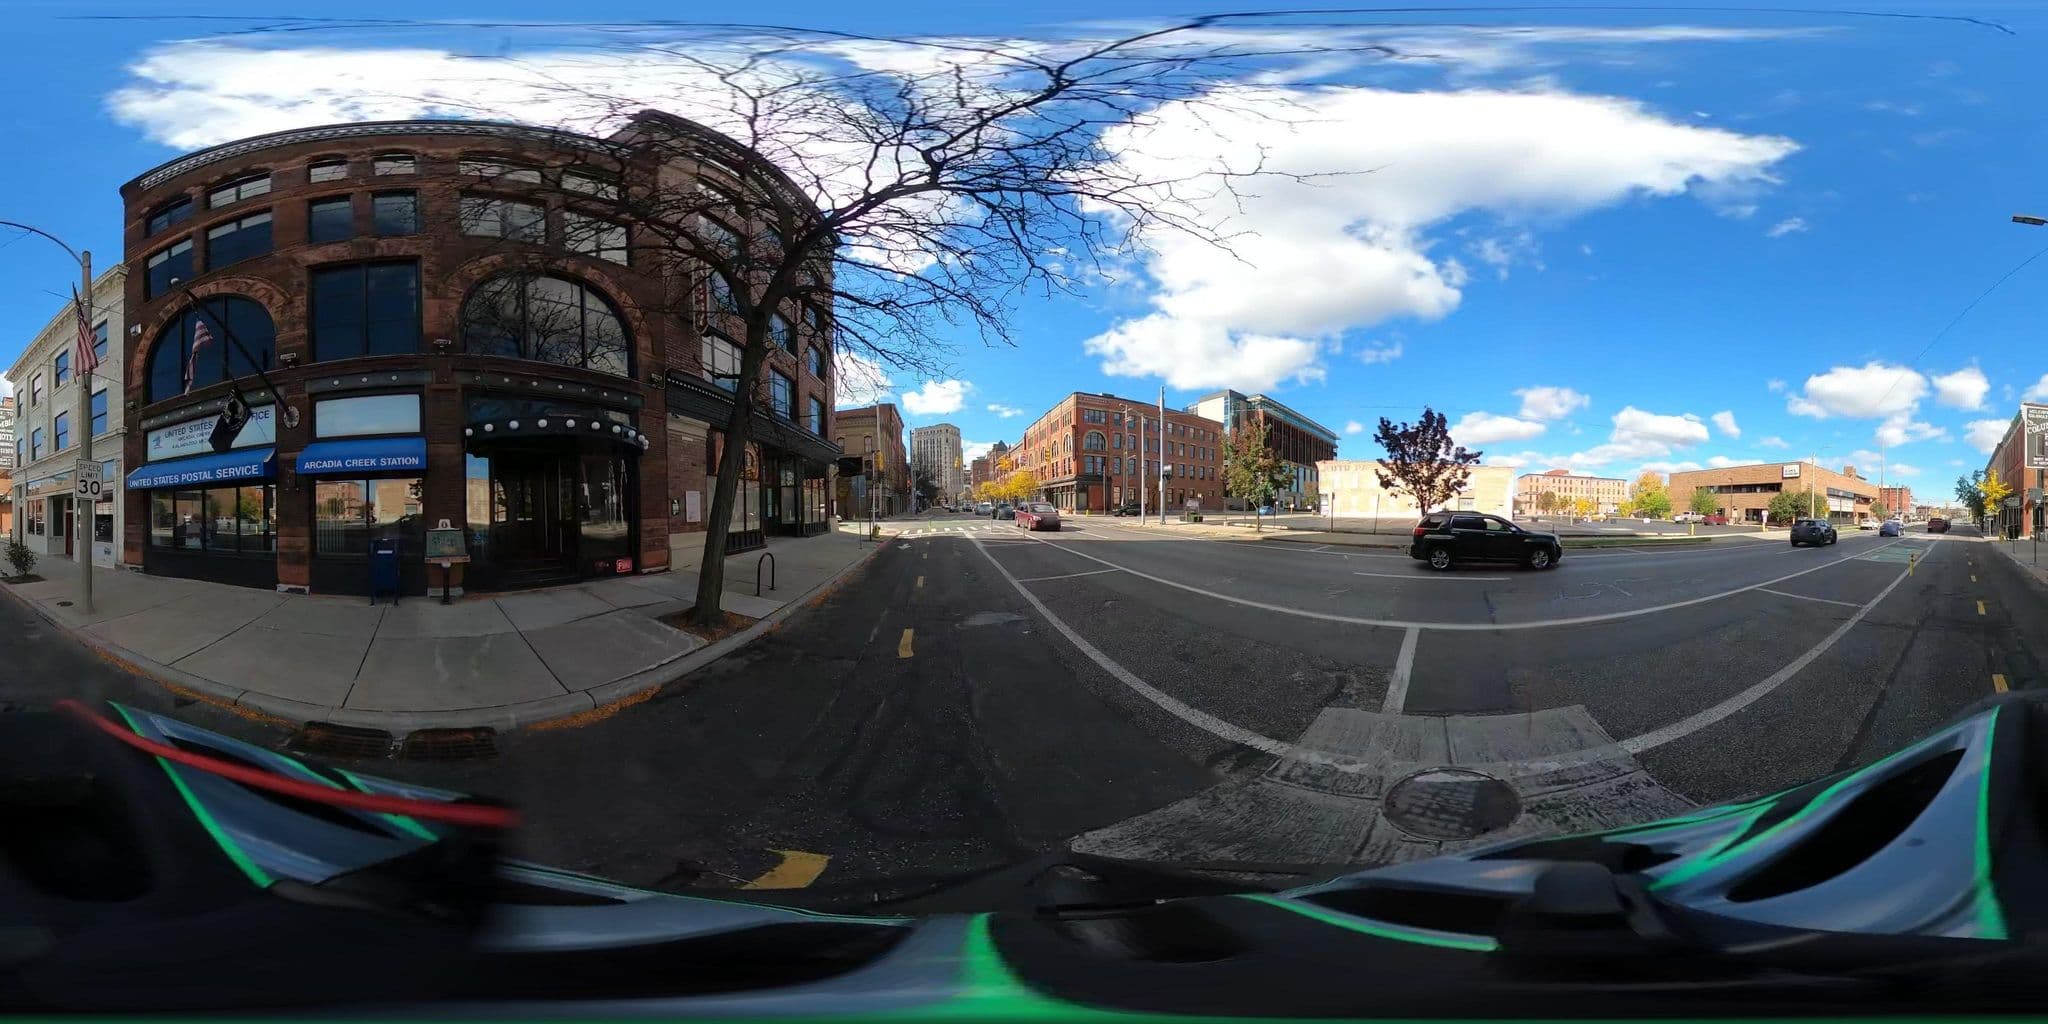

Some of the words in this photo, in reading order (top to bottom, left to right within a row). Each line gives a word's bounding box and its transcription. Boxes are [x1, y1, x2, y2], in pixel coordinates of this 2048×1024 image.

[250, 409, 270, 421] FICE
[165, 427, 187, 438] UNITED
[189, 421, 213, 433] STATES
[80, 463, 101, 472] SPEED
[304, 460, 343, 470] ARCADIA
[345, 458, 377, 468] CREEK
[380, 456, 419, 466] STATION
[129, 479, 152, 488] UNITED
[153, 475, 179, 486] STATES
[181, 470, 213, 482] POSTAL
[216, 464, 259, 479] SERVICE
[78, 479, 100, 495] 30
